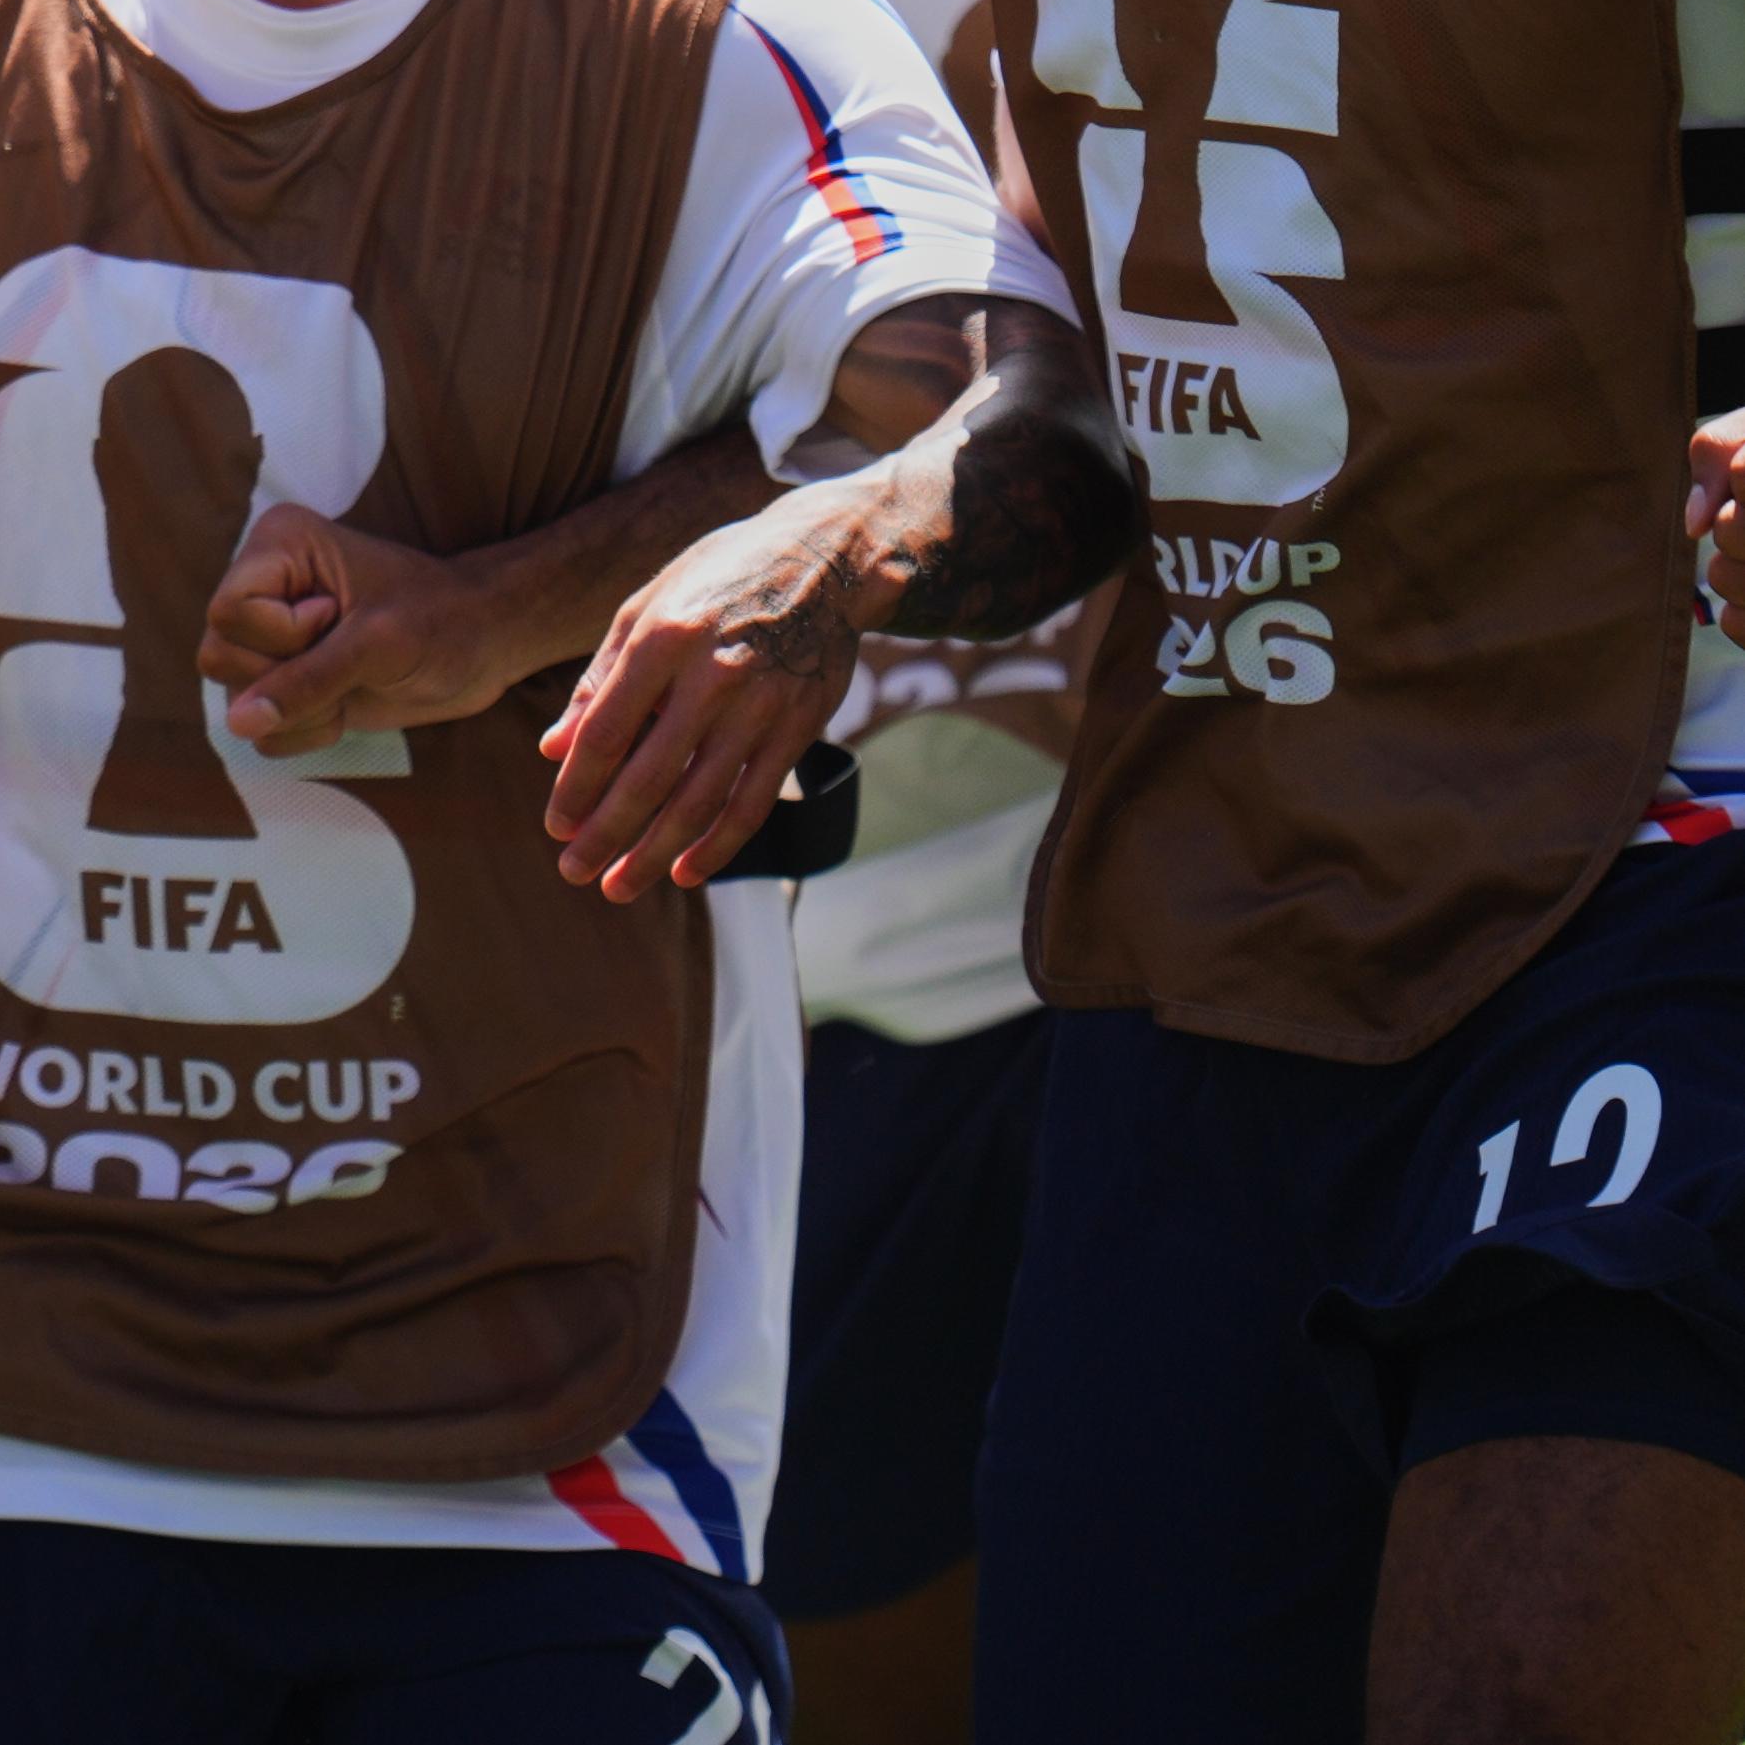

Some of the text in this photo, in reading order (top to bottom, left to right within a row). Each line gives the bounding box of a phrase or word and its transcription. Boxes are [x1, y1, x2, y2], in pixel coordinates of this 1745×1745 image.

[1117, 352, 1262, 442] FIFA
[79, 870, 283, 954] FIFA
[253, 1060, 421, 1122] CUP
